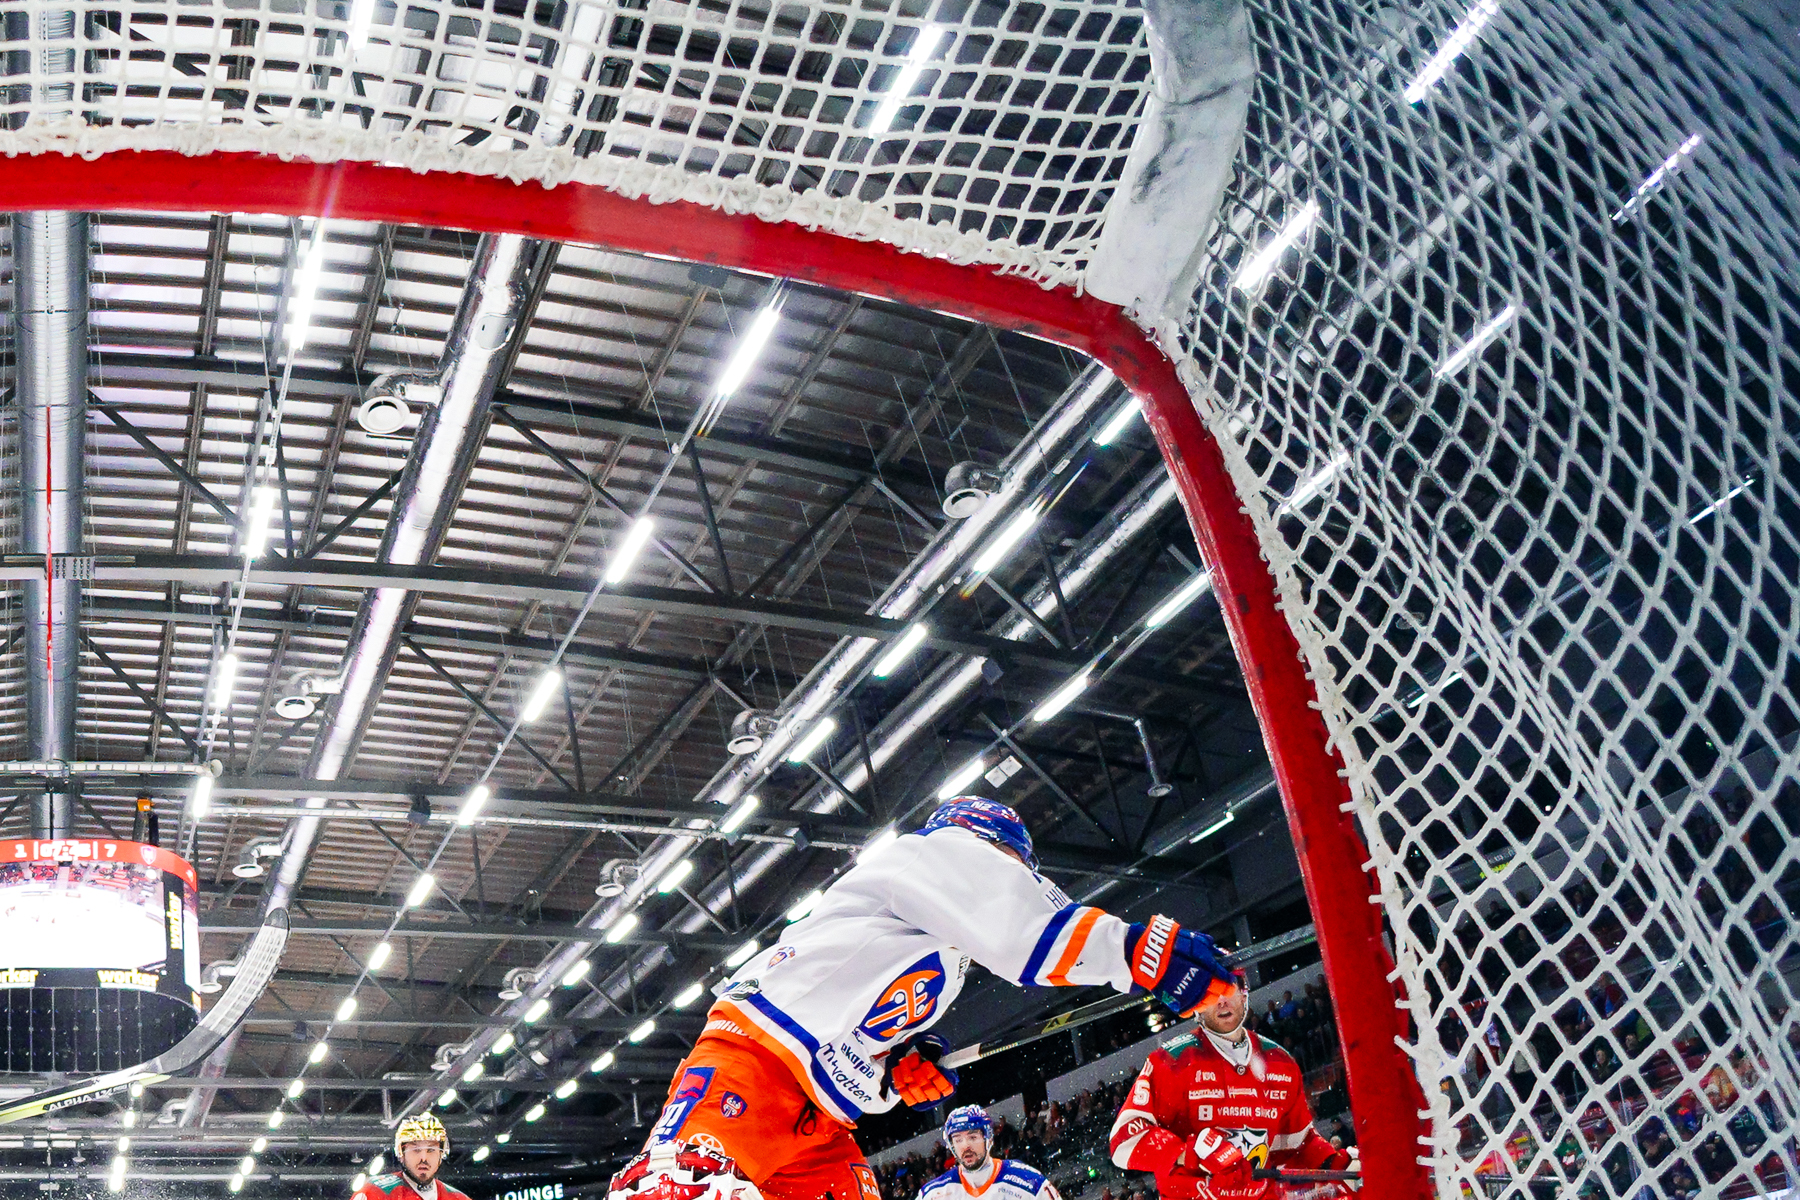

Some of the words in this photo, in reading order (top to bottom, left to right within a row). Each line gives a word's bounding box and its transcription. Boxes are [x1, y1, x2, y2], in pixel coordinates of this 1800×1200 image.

[104, 843, 117, 858] 7
[167, 892, 181, 950] worker
[97, 968, 159, 988] worker
[1173, 966, 1199, 996] VIITA
[49, 1094, 92, 1112] ALPHA
[1217, 1105, 1253, 1117] VAASAN
